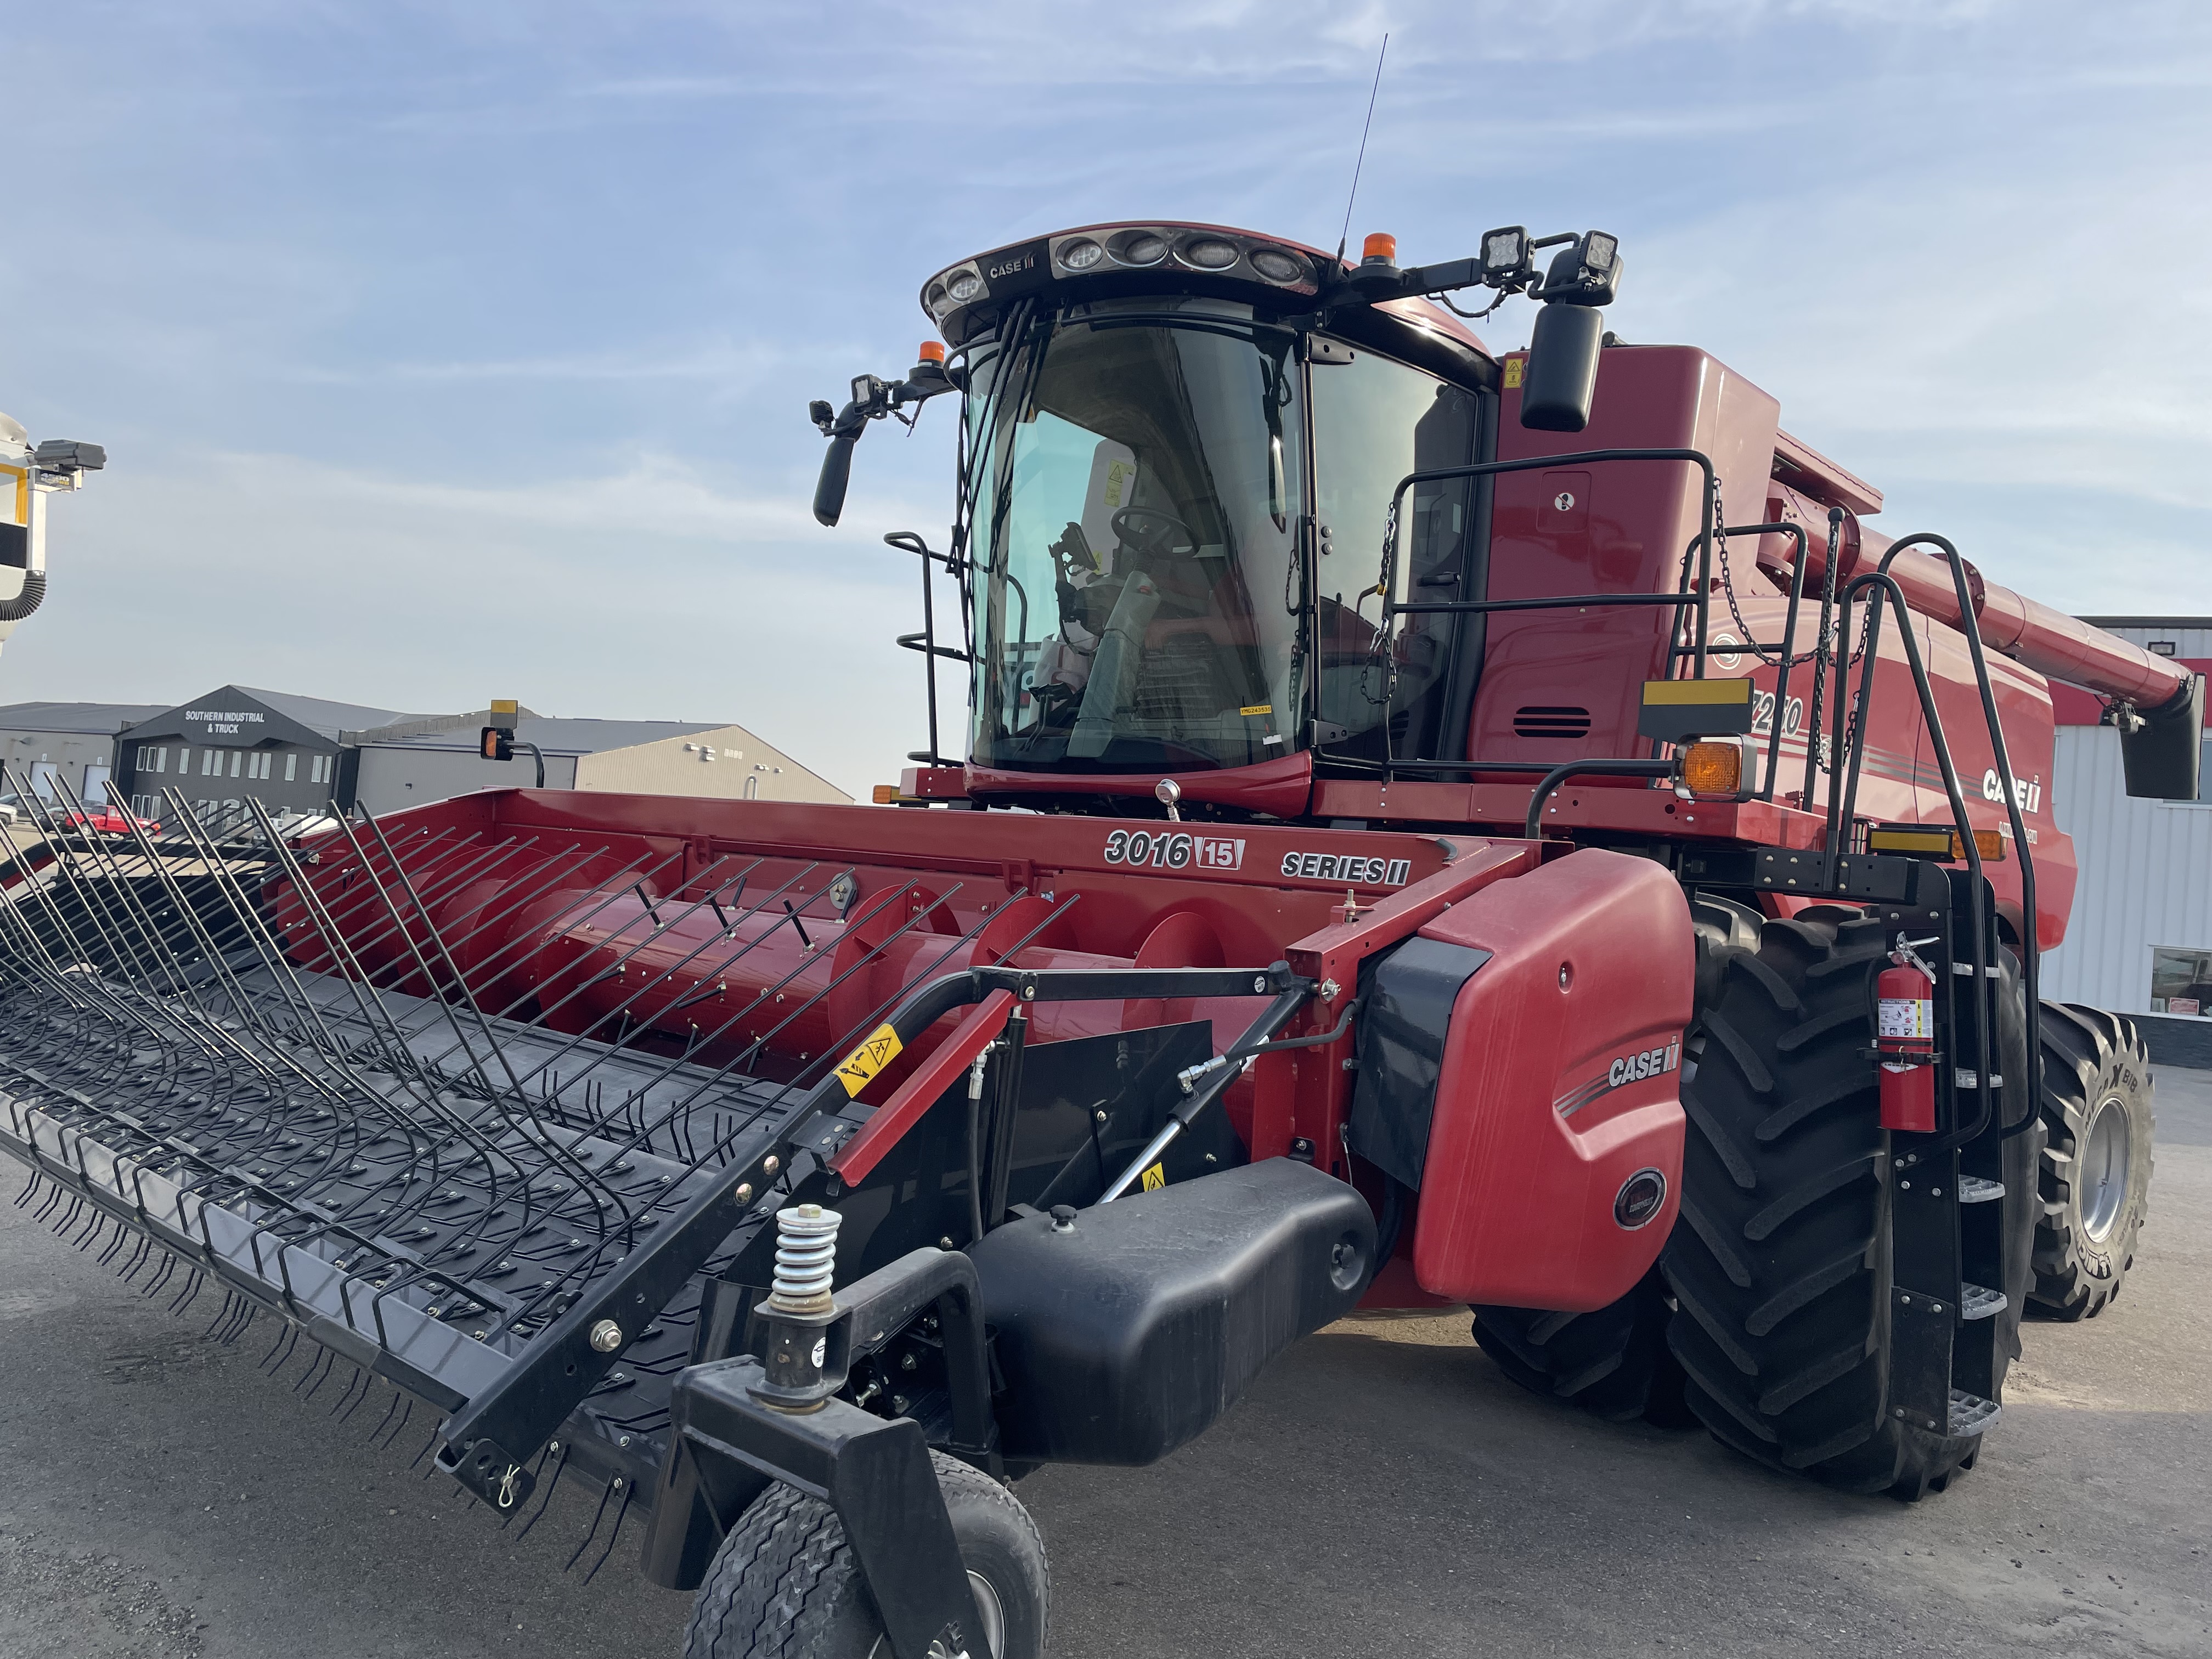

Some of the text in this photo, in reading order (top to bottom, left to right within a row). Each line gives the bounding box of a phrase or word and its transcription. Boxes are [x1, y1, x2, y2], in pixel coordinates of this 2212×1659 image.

[990, 261, 1022, 279] CASE
[185, 710, 265, 723] SOUTHERN INDUSTRIAL
[207, 723, 239, 734] & TRUCK
[1983, 769, 2027, 809] CAE
[1104, 829, 1233, 869] 3016 15
[1280, 851, 1386, 884] SERIES
[1609, 1048, 1663, 1087] CASE
